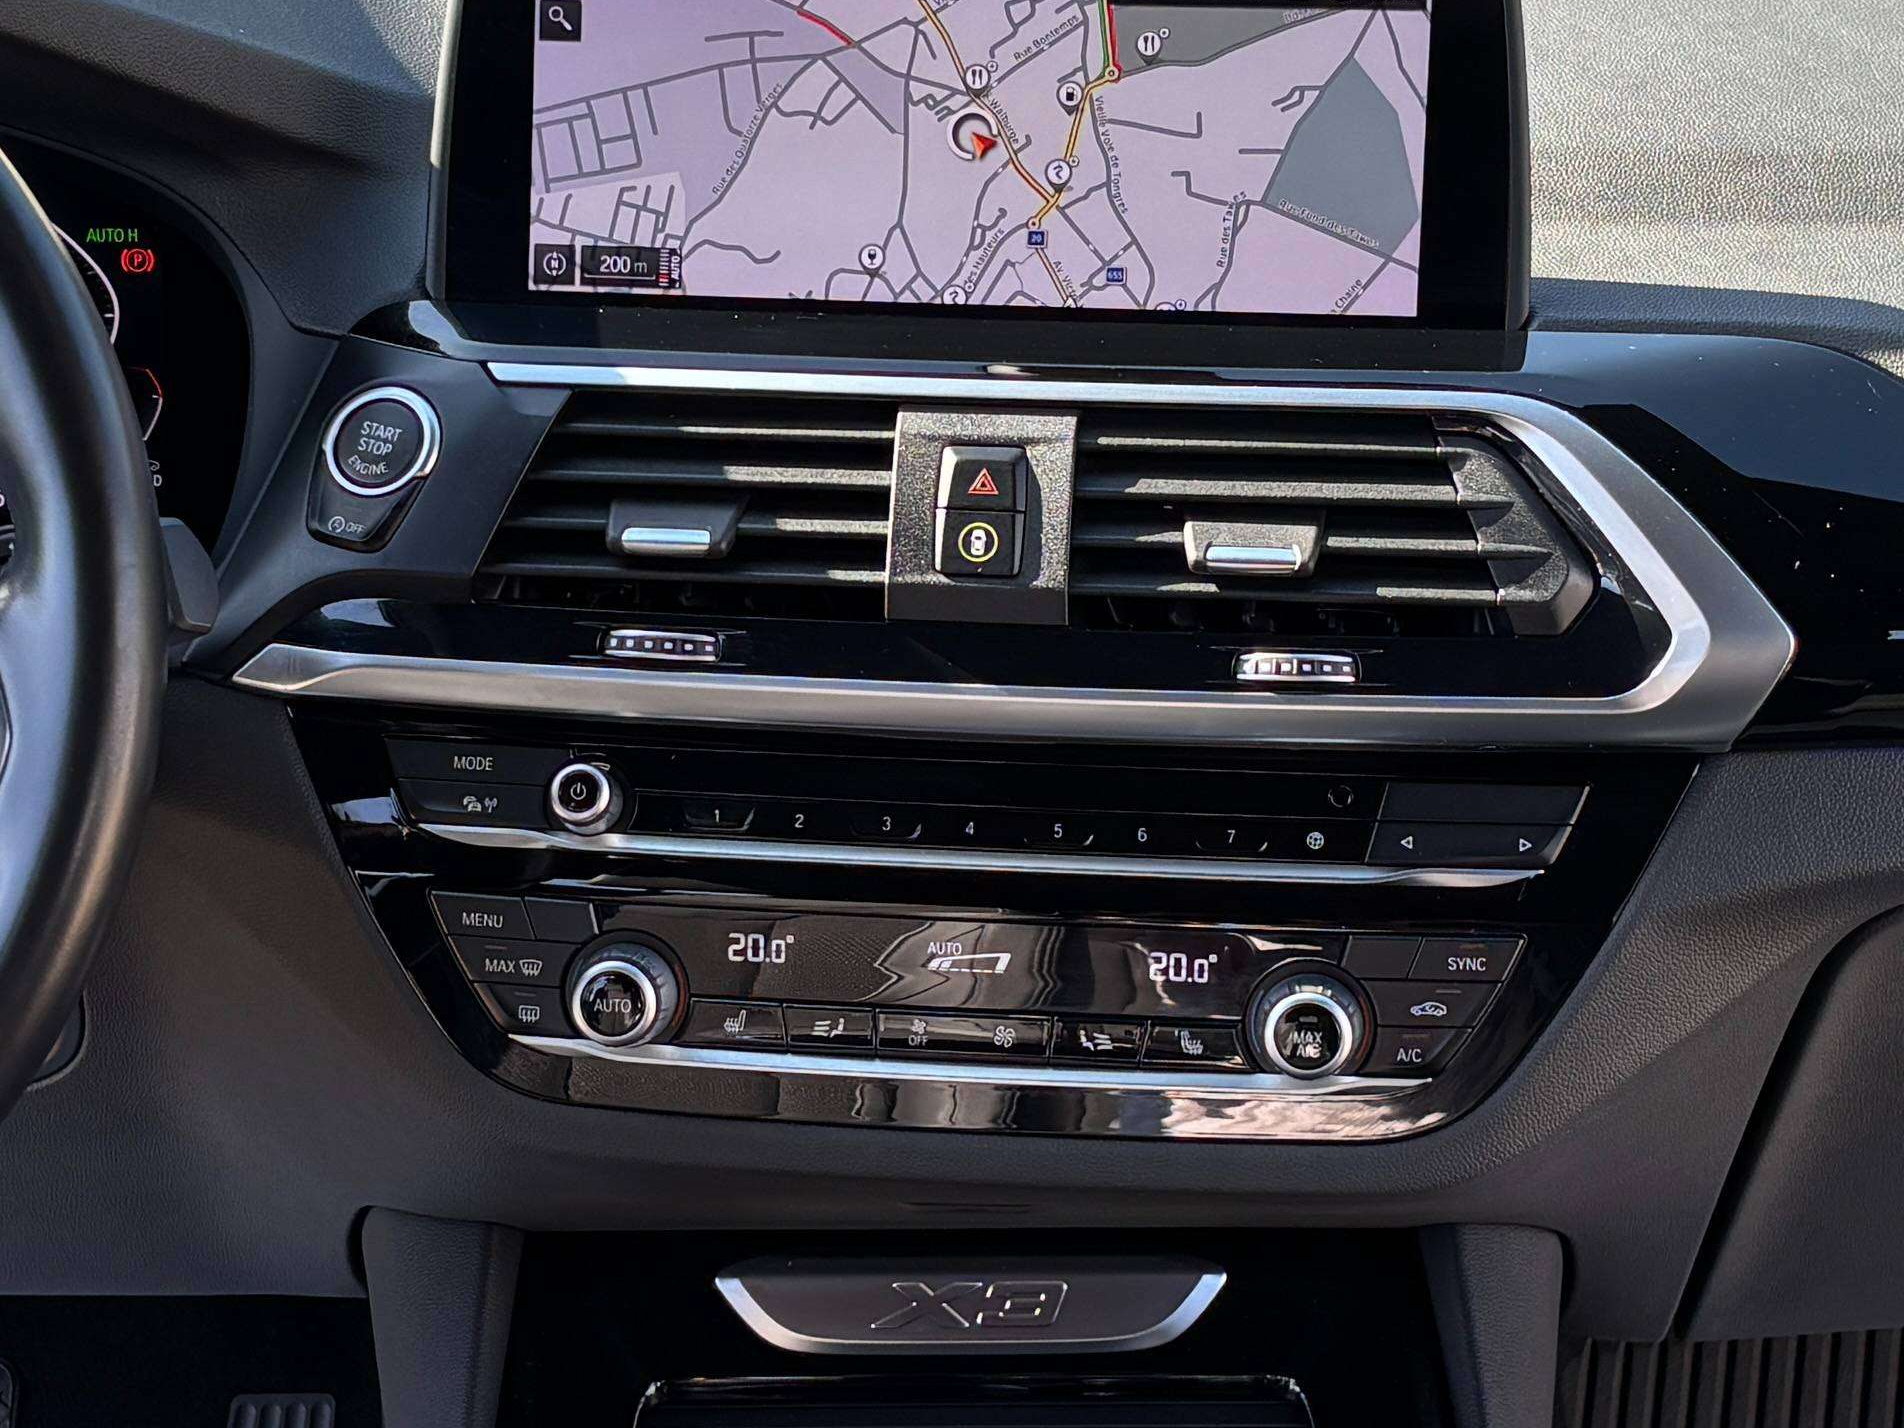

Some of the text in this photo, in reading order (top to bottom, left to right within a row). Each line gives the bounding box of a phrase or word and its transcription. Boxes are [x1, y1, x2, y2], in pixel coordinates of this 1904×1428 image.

[1013, 14, 1080, 62] Rue Bontemps
[86, 227, 139, 243] AUTO H
[599, 255, 648, 274] 200 m
[1216, 246, 1227, 269] Rue
[360, 420, 403, 443] START
[357, 437, 393, 456] STOP
[347, 454, 389, 476] ENGINE
[345, 522, 367, 534] OFF
[453, 755, 494, 772] MODE
[712, 808, 721, 823] 1
[794, 813, 805, 829] 2
[881, 816, 893, 832] 3
[964, 821, 975, 836] 4
[1053, 823, 1064, 839] 5
[1137, 827, 1148, 843] 6
[1226, 829, 1237, 844] 7
[461, 911, 504, 929] MENU
[926, 941, 963, 956] AUTO
[484, 957, 516, 974] MAX
[1447, 956, 1487, 972] SYNC
[593, 998, 632, 1015] AUTO
[908, 1034, 929, 1047] OFF
[1292, 1030, 1323, 1045] MAX
[1396, 1048, 1423, 1063] A/C
[869, 1279, 1070, 1330] X3
